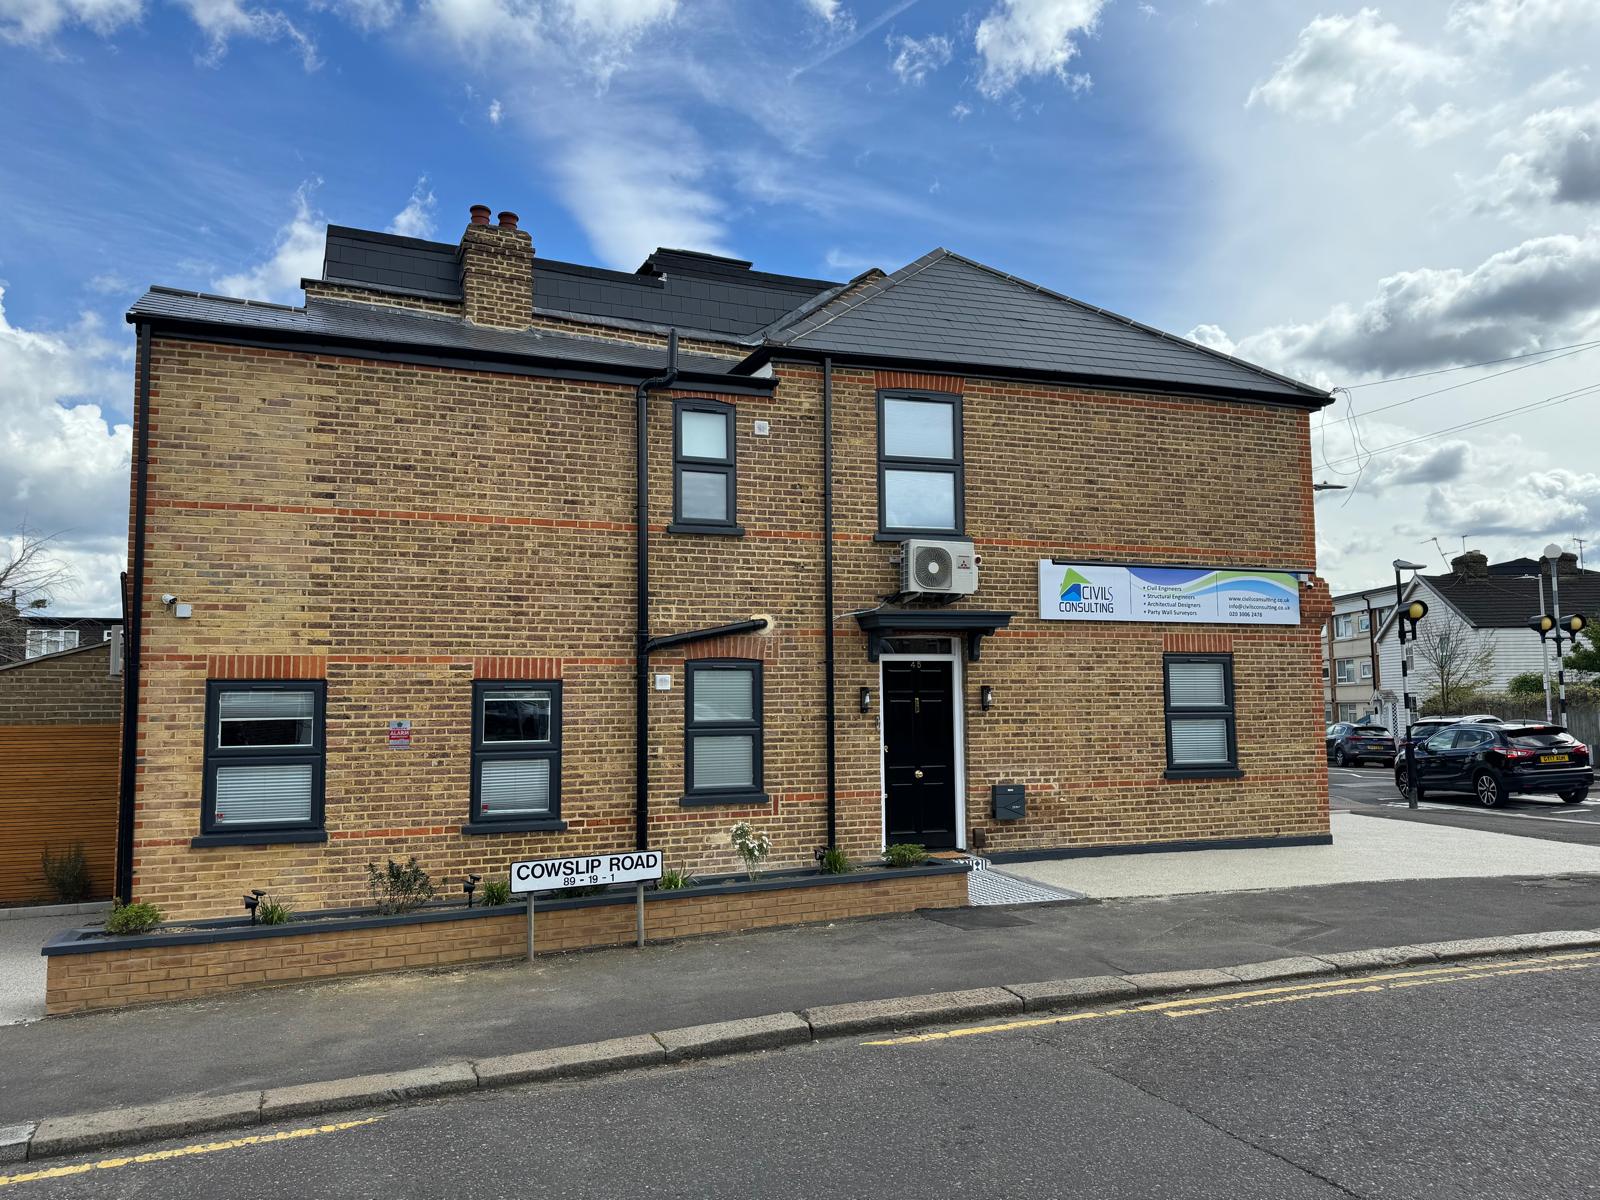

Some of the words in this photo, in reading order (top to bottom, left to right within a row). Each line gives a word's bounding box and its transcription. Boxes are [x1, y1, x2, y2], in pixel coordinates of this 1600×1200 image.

[1082, 586, 1114, 602] CIVILS
[1228, 596, 1290, 604] www.civilsconsulting.co.uk
[1058, 601, 1114, 614] CONSULTING
[1173, 609, 1197, 617] Surveyors
[516, 858, 602, 881] COWSLIP
[609, 854, 658, 872] ROAD
[563, 876, 576, 886] 89
[588, 875, 599, 884] 19
[610, 873, 615, 882] 1
